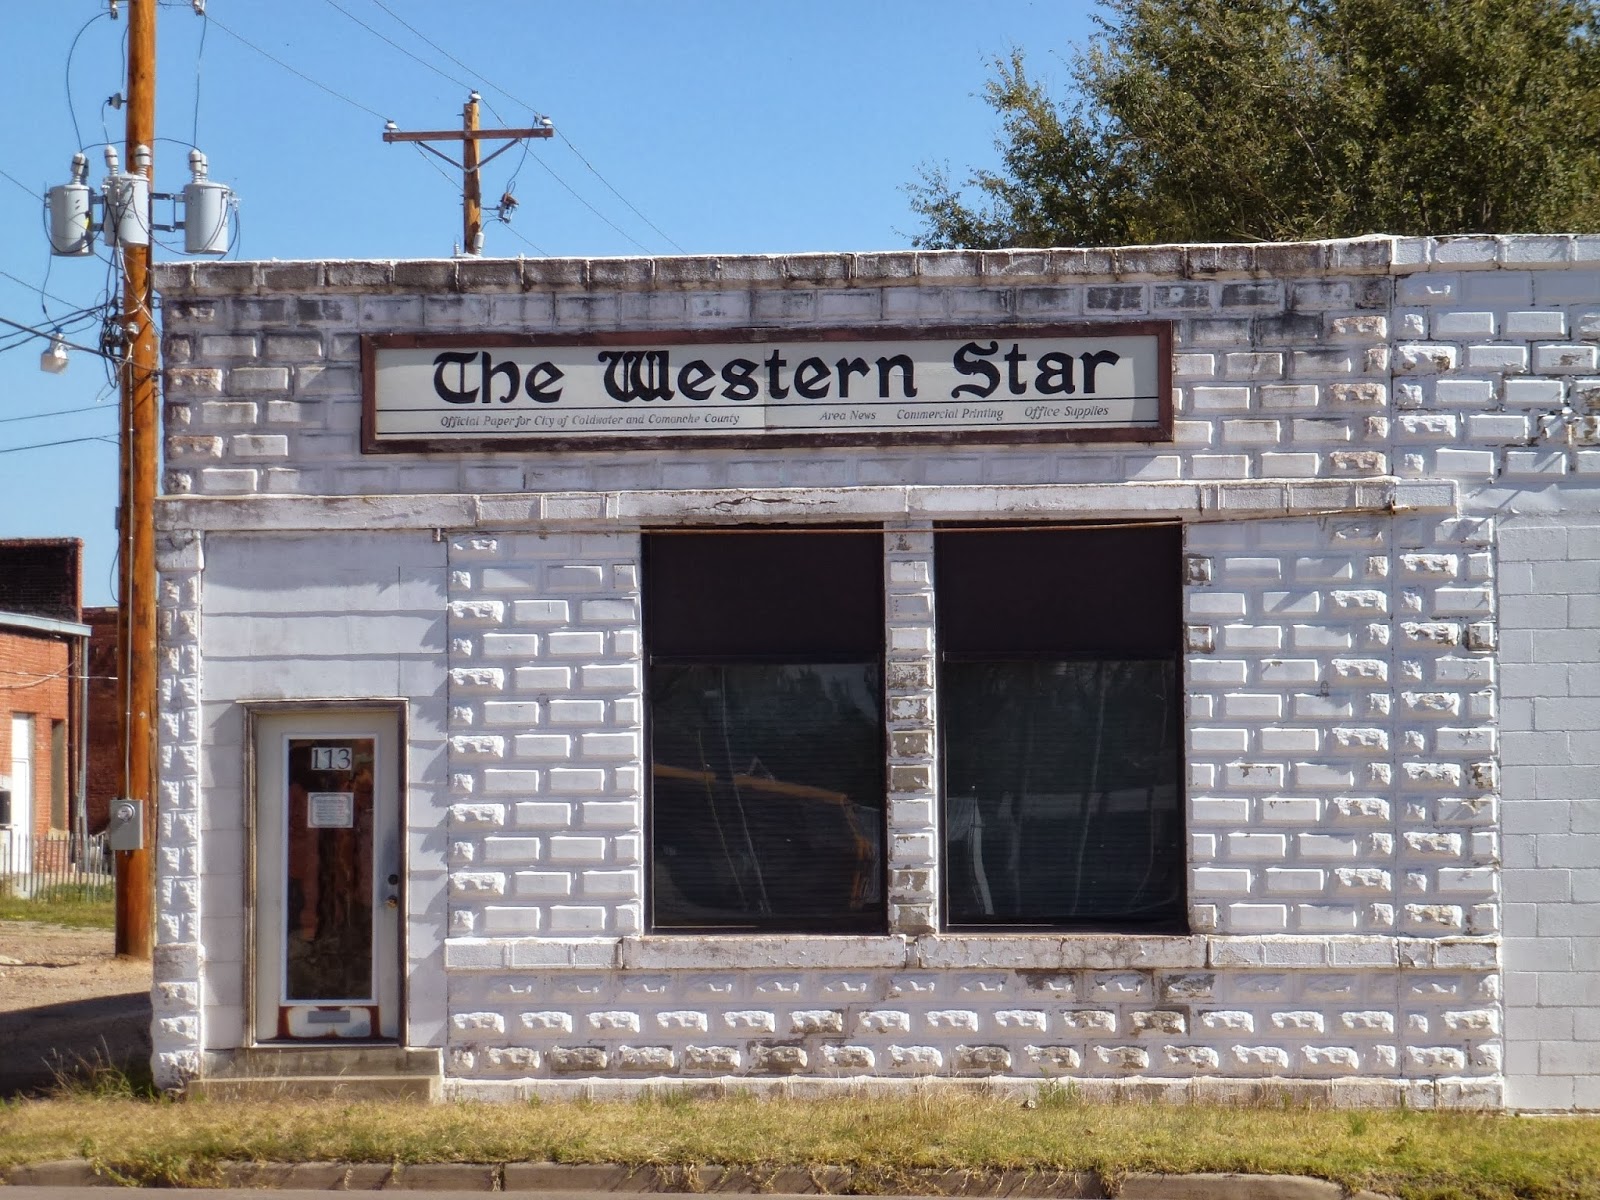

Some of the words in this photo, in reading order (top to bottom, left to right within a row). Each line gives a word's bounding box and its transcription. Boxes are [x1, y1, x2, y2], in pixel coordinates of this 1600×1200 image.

[433, 351, 565, 404] The
[598, 348, 918, 402] Western
[951, 341, 1120, 398] Star
[819, 411, 846, 421] Area
[850, 410, 876, 420] News
[896, 408, 958, 420] Commercial
[962, 408, 1004, 421] Printing
[1024, 406, 1060, 420] Office
[1064, 405, 1109, 419] Supplies
[440, 415, 479, 429] Official
[483, 415, 514, 428] Paper
[514, 415, 531, 428] for
[534, 415, 554, 427] City
[557, 414, 569, 428] of
[572, 415, 623, 425] Coldwater
[626, 414, 645, 425] and
[648, 413, 700, 425] Comanche
[704, 413, 740, 426] County
[313, 748, 351, 769] 113
